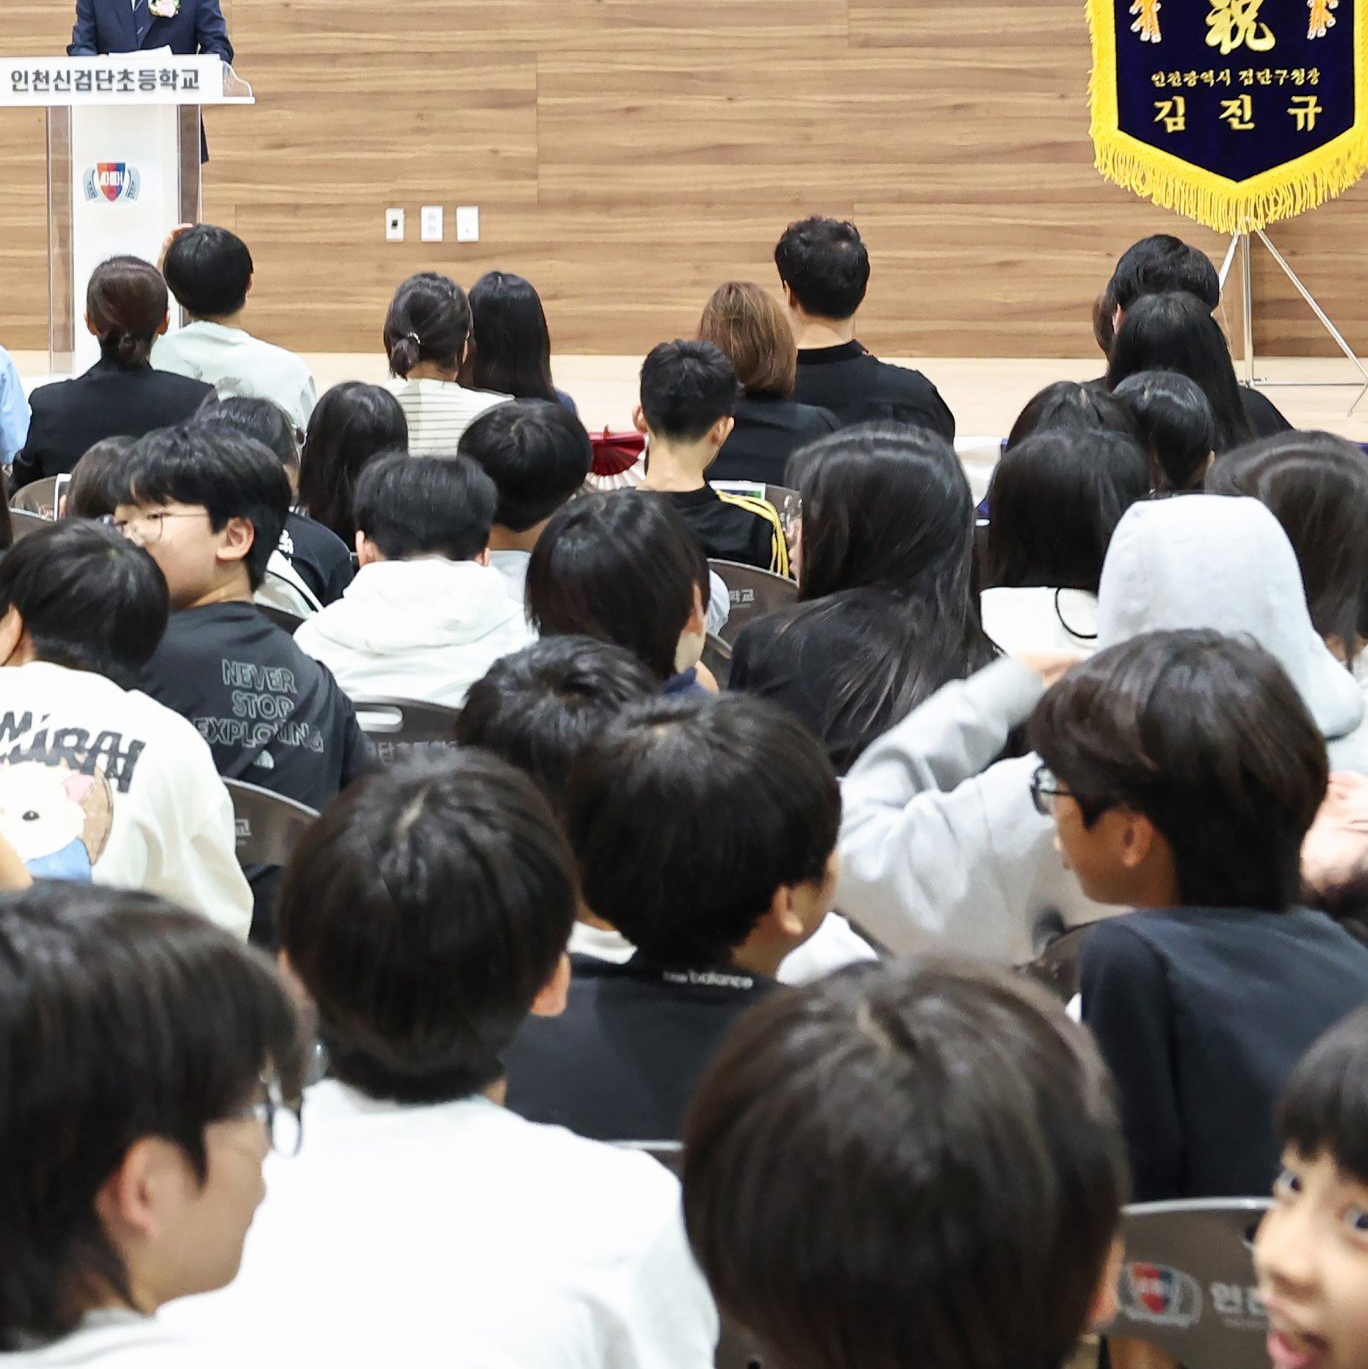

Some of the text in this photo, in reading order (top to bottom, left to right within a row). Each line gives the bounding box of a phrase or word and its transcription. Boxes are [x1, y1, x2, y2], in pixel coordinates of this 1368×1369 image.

[10, 68, 200, 93] 인천신검단초등학교
[1151, 67, 1321, 88] 인천광역시 검단구청장
[221, 658, 298, 694] NEVER
[231, 692, 295, 720] STOP
[194, 716, 324, 753] EXPLOING
